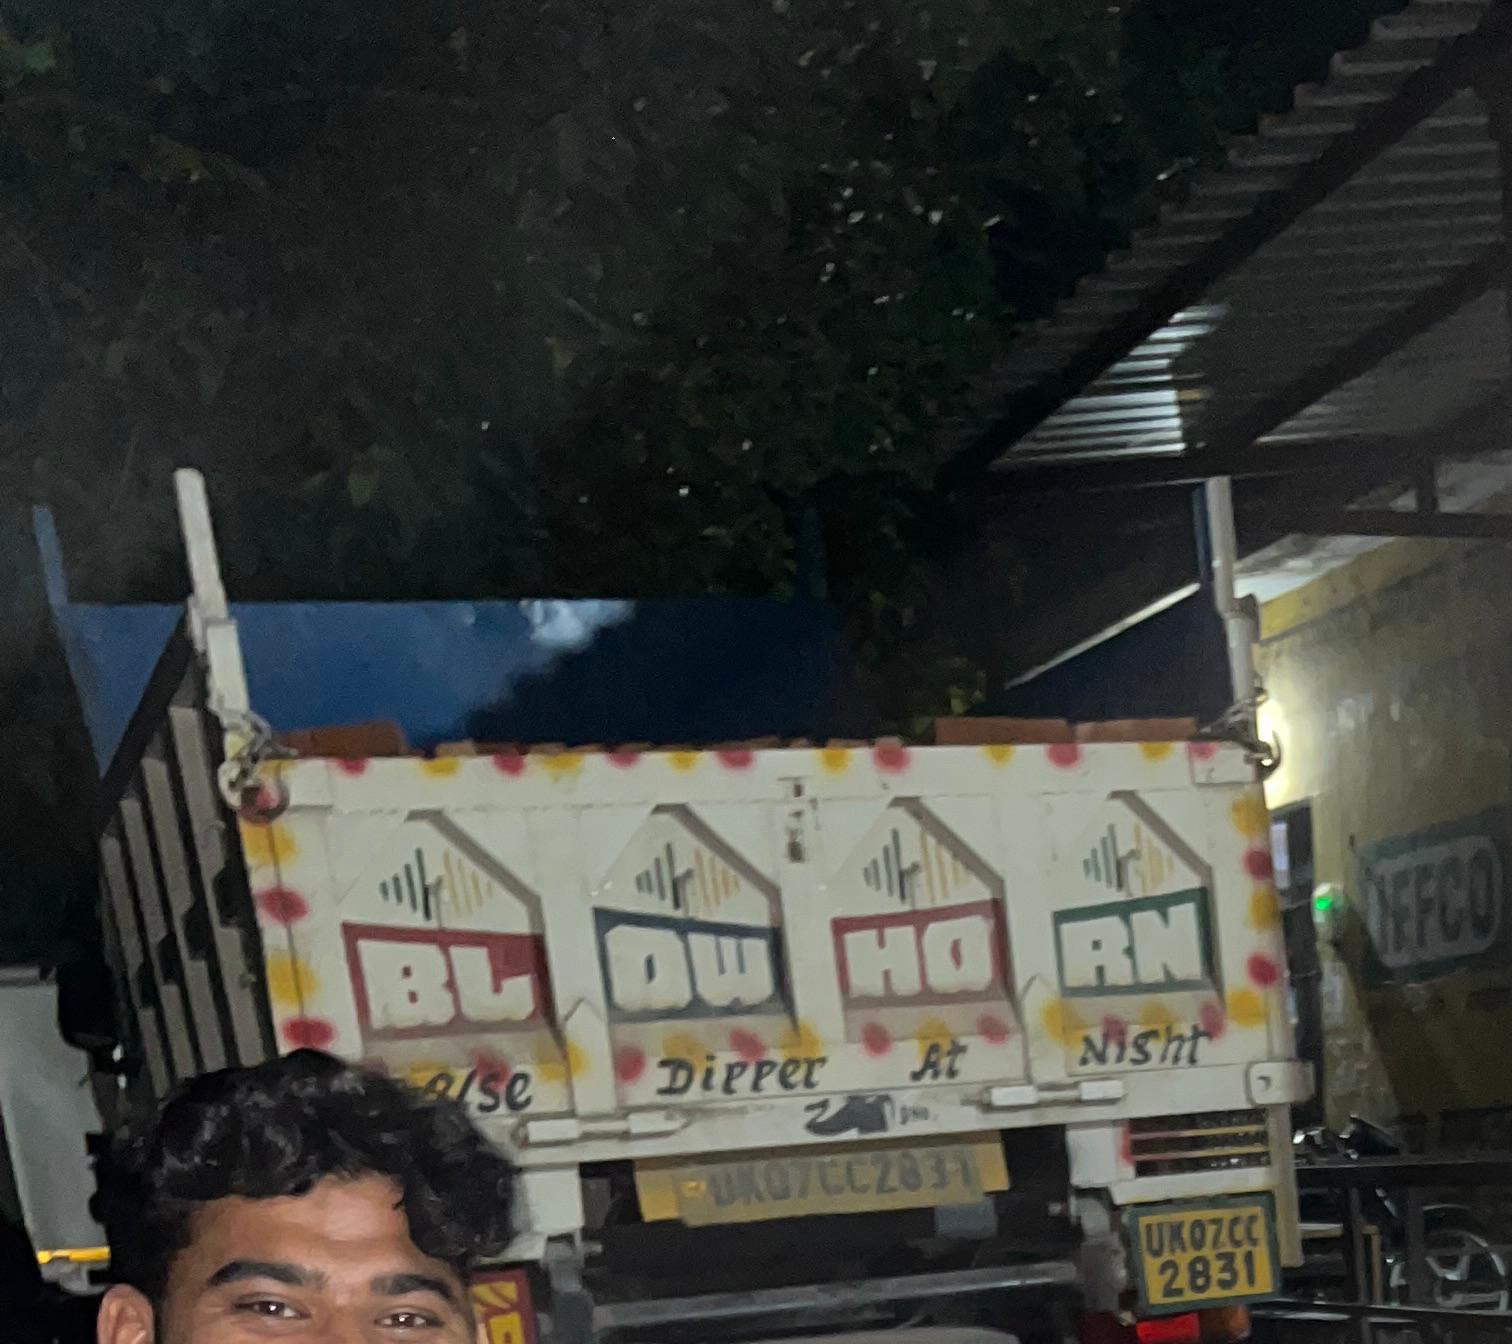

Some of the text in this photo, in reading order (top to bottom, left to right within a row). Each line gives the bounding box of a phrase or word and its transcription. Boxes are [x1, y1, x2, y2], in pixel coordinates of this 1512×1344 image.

[910, 1039, 969, 1081] At
[1145, 1214, 1259, 1259] UK07CC
[1158, 1249, 1256, 1299] 2831
